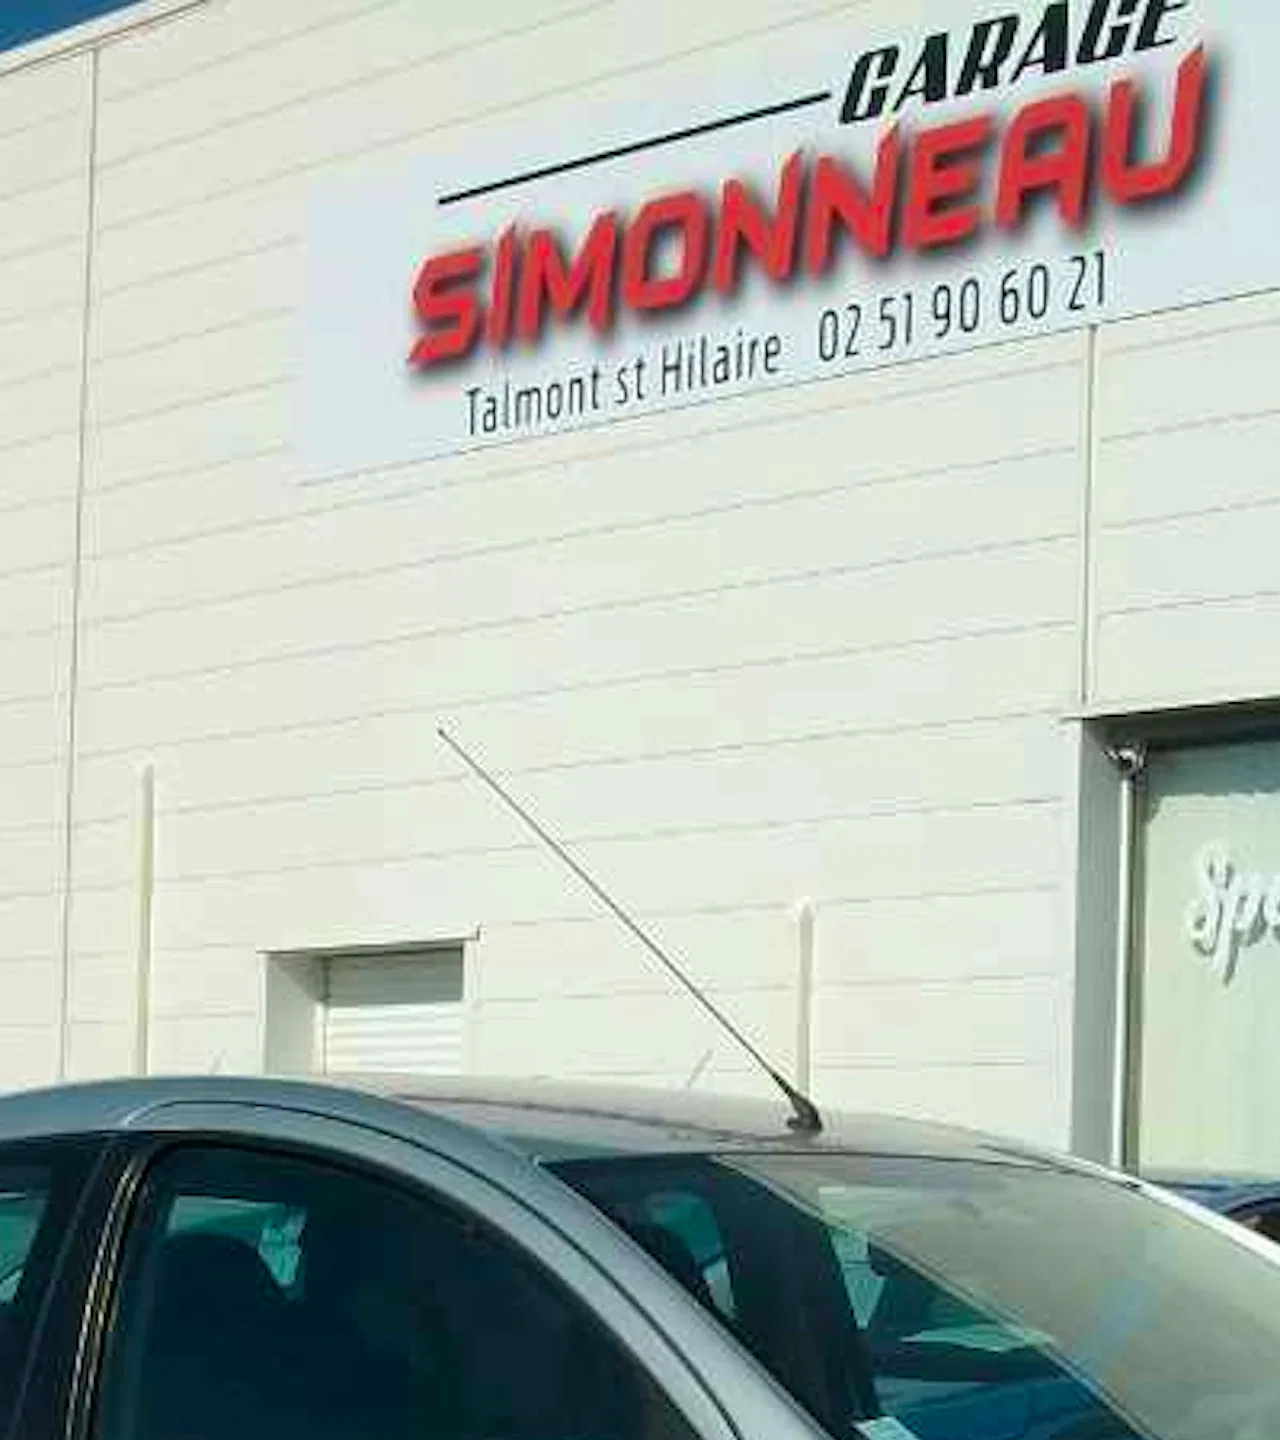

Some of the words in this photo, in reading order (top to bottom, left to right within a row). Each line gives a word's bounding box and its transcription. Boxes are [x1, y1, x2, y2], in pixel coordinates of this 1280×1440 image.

[839, 0, 1188, 124] GARAGE
[407, 44, 1205, 364] SIMONNEAU
[465, 371, 602, 437] Talmont
[613, 353, 646, 405] st
[660, 328, 783, 392] Hilaire
[817, 302, 862, 362] 02
[878, 291, 915, 347] 51
[932, 278, 980, 338] 90
[999, 264, 1050, 325] 60
[1067, 251, 1107, 311] 21
